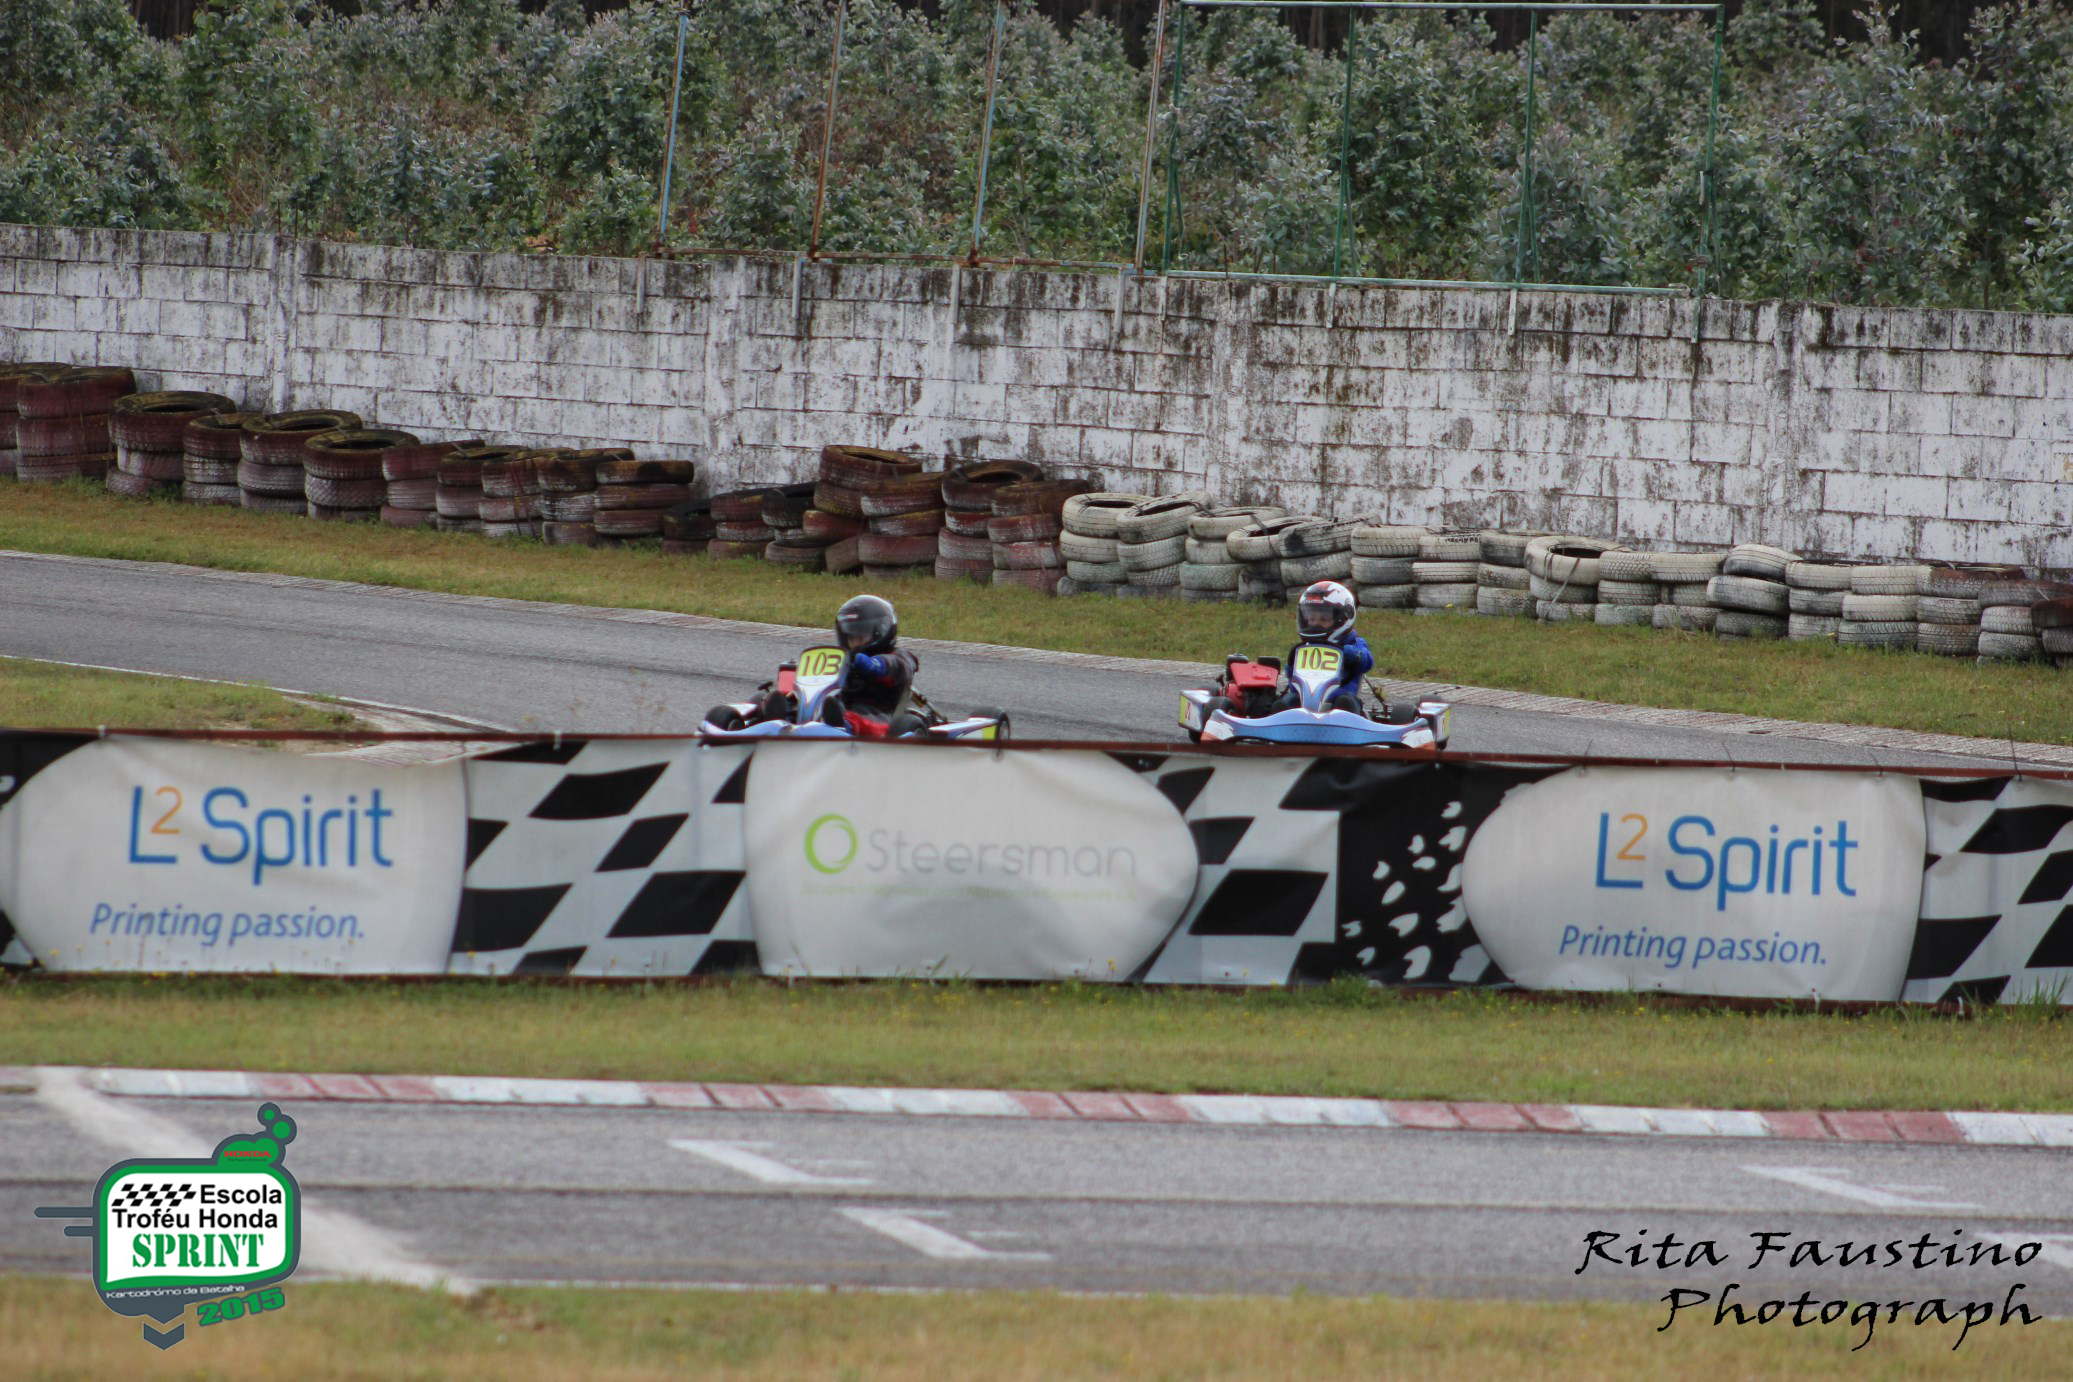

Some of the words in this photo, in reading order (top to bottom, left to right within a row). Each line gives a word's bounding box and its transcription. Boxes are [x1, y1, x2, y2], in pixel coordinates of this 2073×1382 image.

[801, 651, 842, 677] 103
[1300, 646, 1339, 671] 102
[200, 786, 394, 886] Spirit
[865, 827, 1137, 879] Steersman
[1665, 815, 1859, 911] Spirit
[89, 903, 223, 947] Printing
[228, 904, 365, 947] passion.
[1558, 924, 1687, 969] Printing
[1692, 931, 1828, 969] passion.
